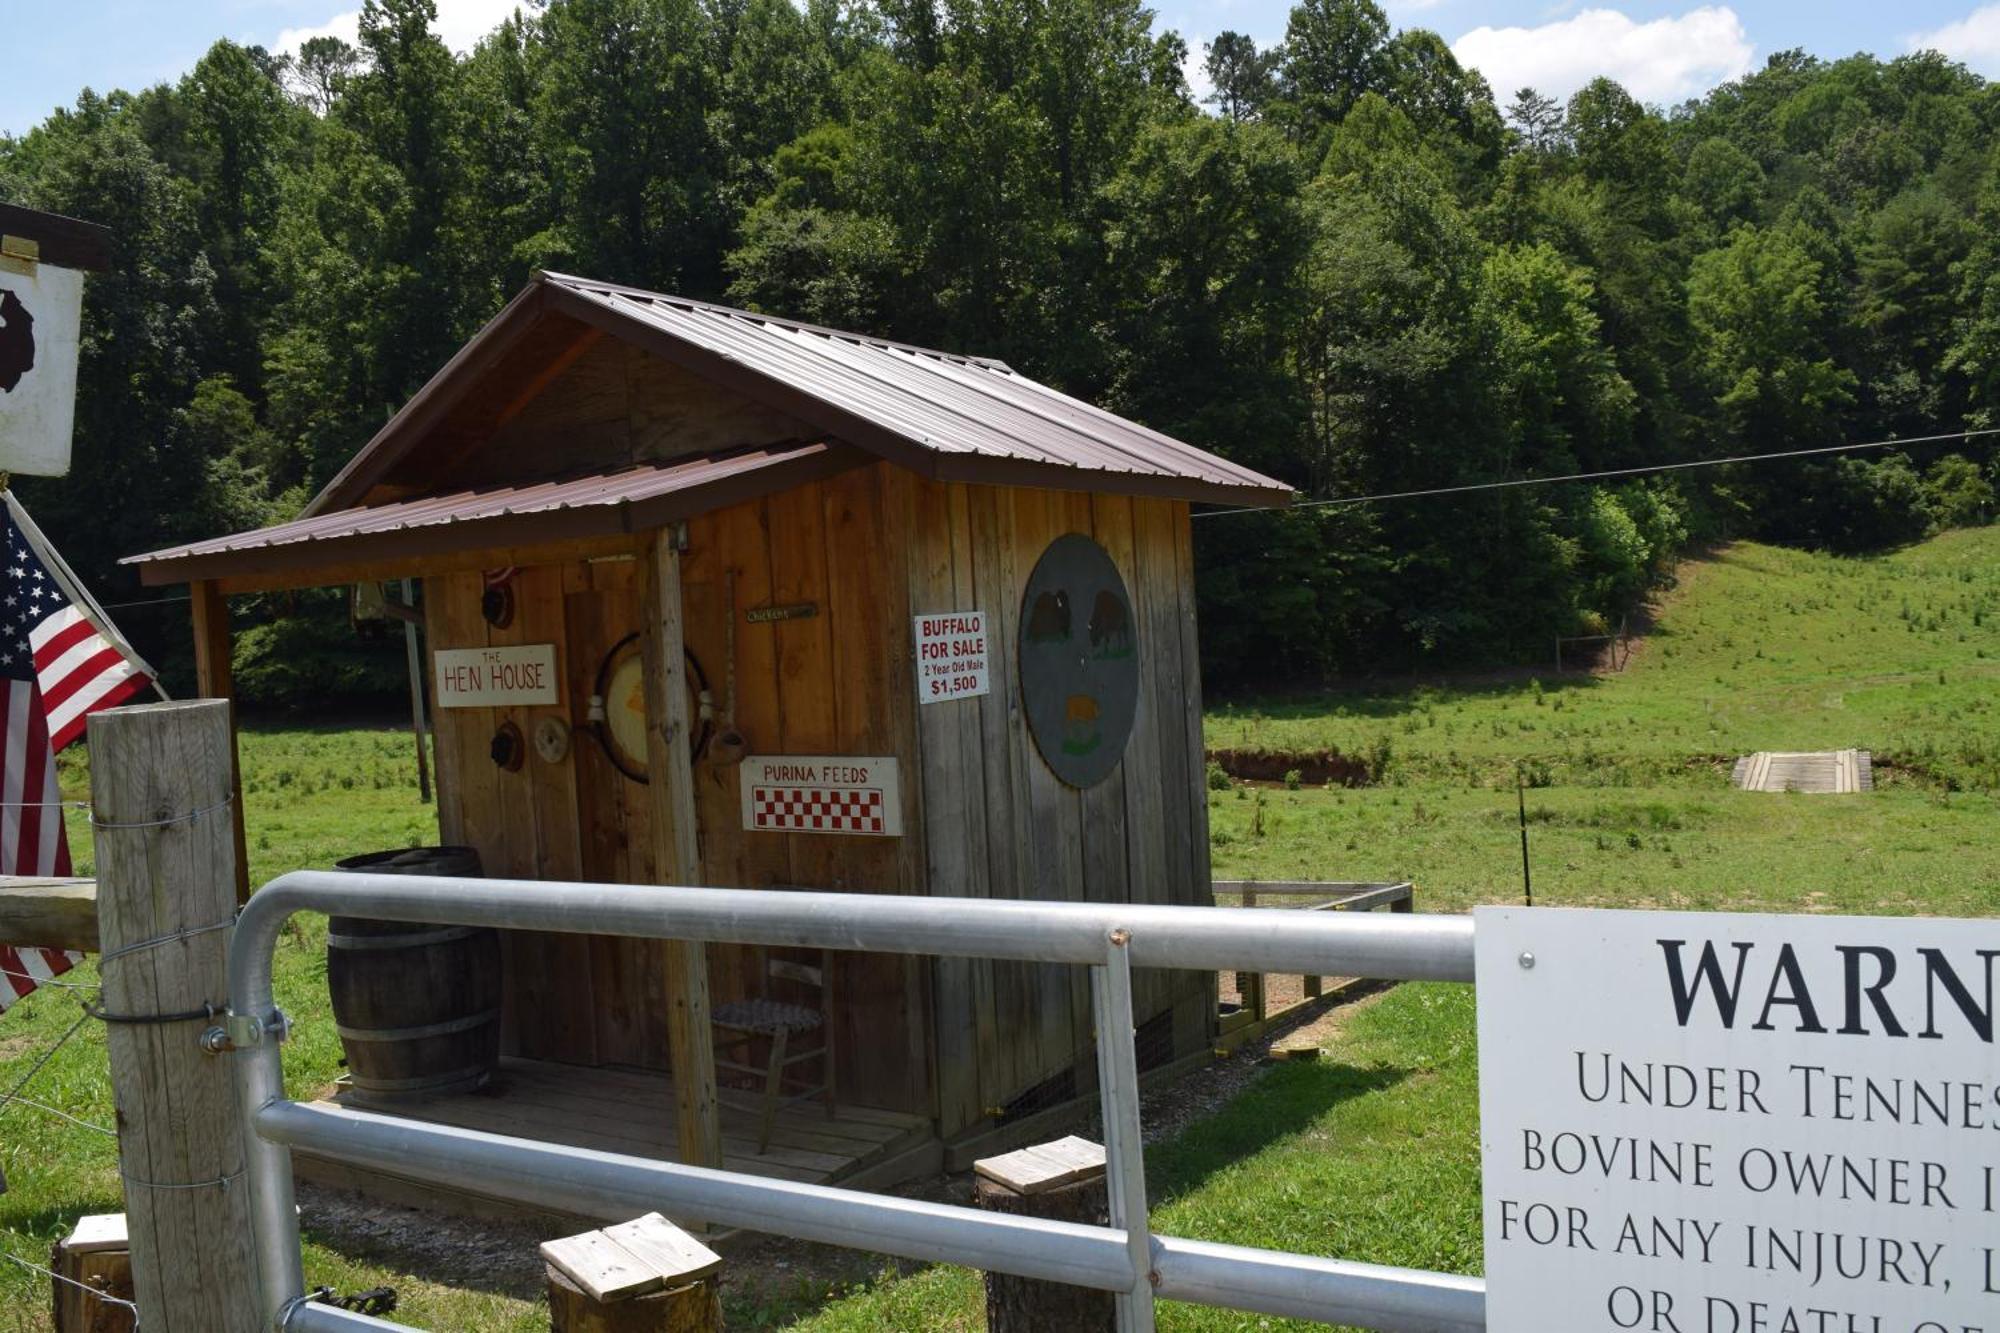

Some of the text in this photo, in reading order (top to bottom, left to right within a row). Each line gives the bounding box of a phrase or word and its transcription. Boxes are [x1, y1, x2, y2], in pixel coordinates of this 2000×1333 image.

[923, 617, 980, 636] BUFFALO
[482, 652, 501, 663] THE
[922, 638, 984, 660] FOR SALE
[444, 663, 545, 692] HEN HOUSE
[925, 665, 930, 676] 2
[932, 663, 950, 675] Year
[952, 661, 965, 672] Old
[931, 675, 977, 696] $1,500
[764, 765, 868, 784] PURINA FEEDS
[1656, 938, 2000, 1043] WARN
[1574, 1051, 1771, 1115] UNDER
[1522, 1128, 1714, 1188] BOVINE
[1739, 1148, 1958, 1210] OWNER
[1499, 1200, 1598, 1251] FOR
[1612, 1212, 1723, 1264] ANY
[1746, 1225, 1951, 1295] INJURY,
[1607, 1285, 1683, 1333] OR
